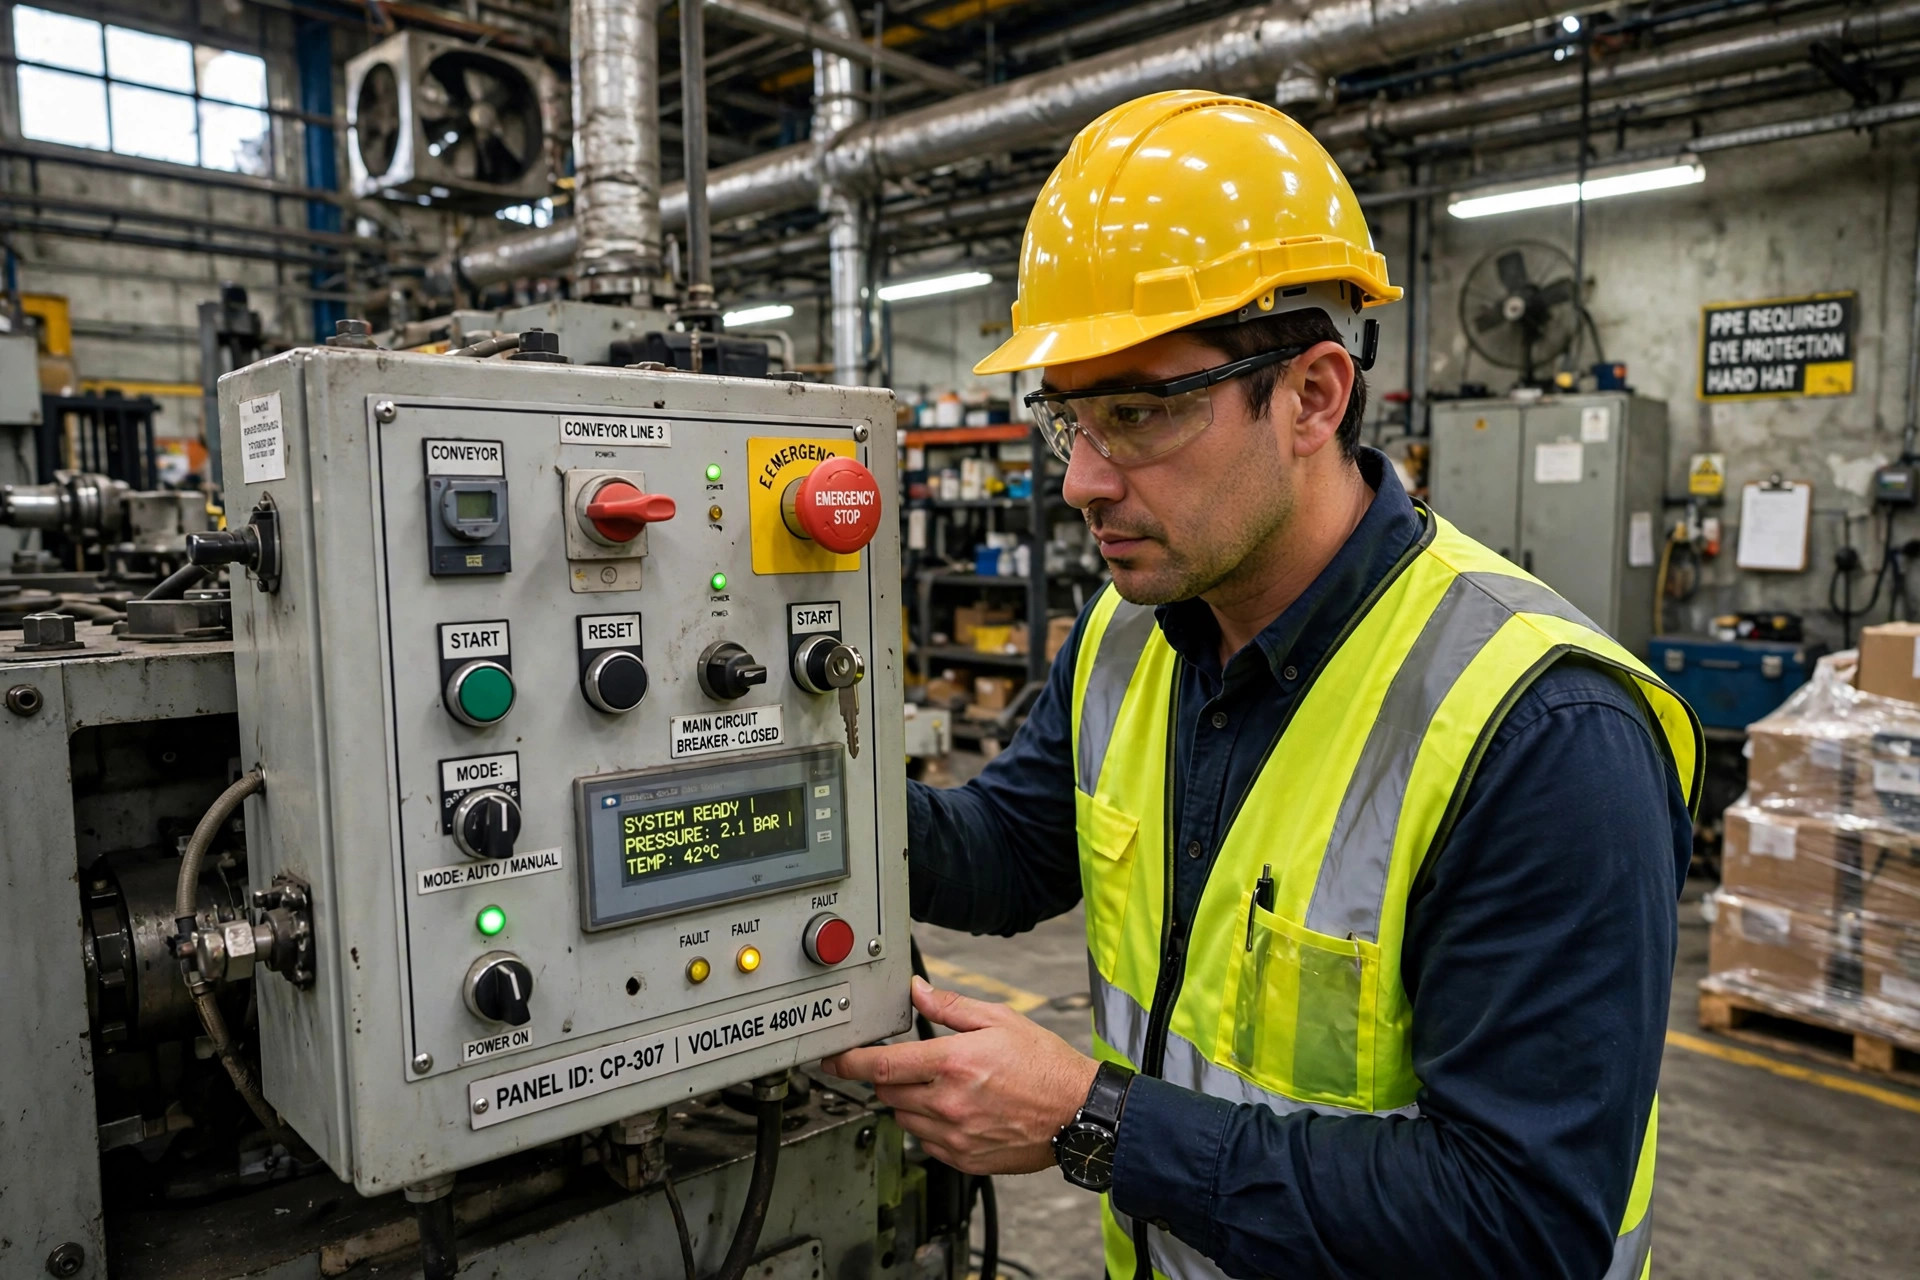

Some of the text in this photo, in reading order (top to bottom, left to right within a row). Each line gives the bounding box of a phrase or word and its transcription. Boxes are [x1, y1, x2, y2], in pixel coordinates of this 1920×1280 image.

[1710, 302, 1843, 336] PPE REQUIRED
[1708, 333, 1845, 365] EYE PROTECTION
[1707, 364, 1797, 392] HARD HAT
[565, 422, 664, 439] CONVEYOR LINE 3
[431, 445, 498, 461] CONVEYOR
[815, 490, 875, 506] EMERGENCY
[834, 509, 860, 525] STOP
[797, 610, 833, 626] START
[451, 631, 500, 649] START
[588, 622, 634, 640] RESET
[682, 712, 758, 734] MAIN CIRCUIT
[677, 734, 729, 753] BREAKER
[738, 727, 779, 745] CLOSED
[456, 762, 503, 782] MODE:
[624, 809, 685, 834] SYSTEM
[693, 800, 740, 823] READY
[625, 826, 710, 855] PRESSURE:
[720, 820, 746, 839] 2.1
[753, 814, 780, 833] BAR
[423, 870, 464, 889] MODE:
[466, 863, 500, 881] AUTO
[510, 852, 558, 873] MANUAL
[626, 853, 673, 875] TEMP:
[811, 892, 838, 909] FAULT
[731, 919, 760, 936] FAULT
[679, 930, 710, 948] FAULT
[467, 1030, 529, 1057] POWER ON
[496, 1073, 563, 1110] PANEL
[568, 1065, 594, 1089] ID:
[600, 1043, 665, 1079] CP-307
[688, 1016, 765, 1054] VOLTAGE
[769, 1005, 807, 1031] 480V
[811, 998, 833, 1021] AC
